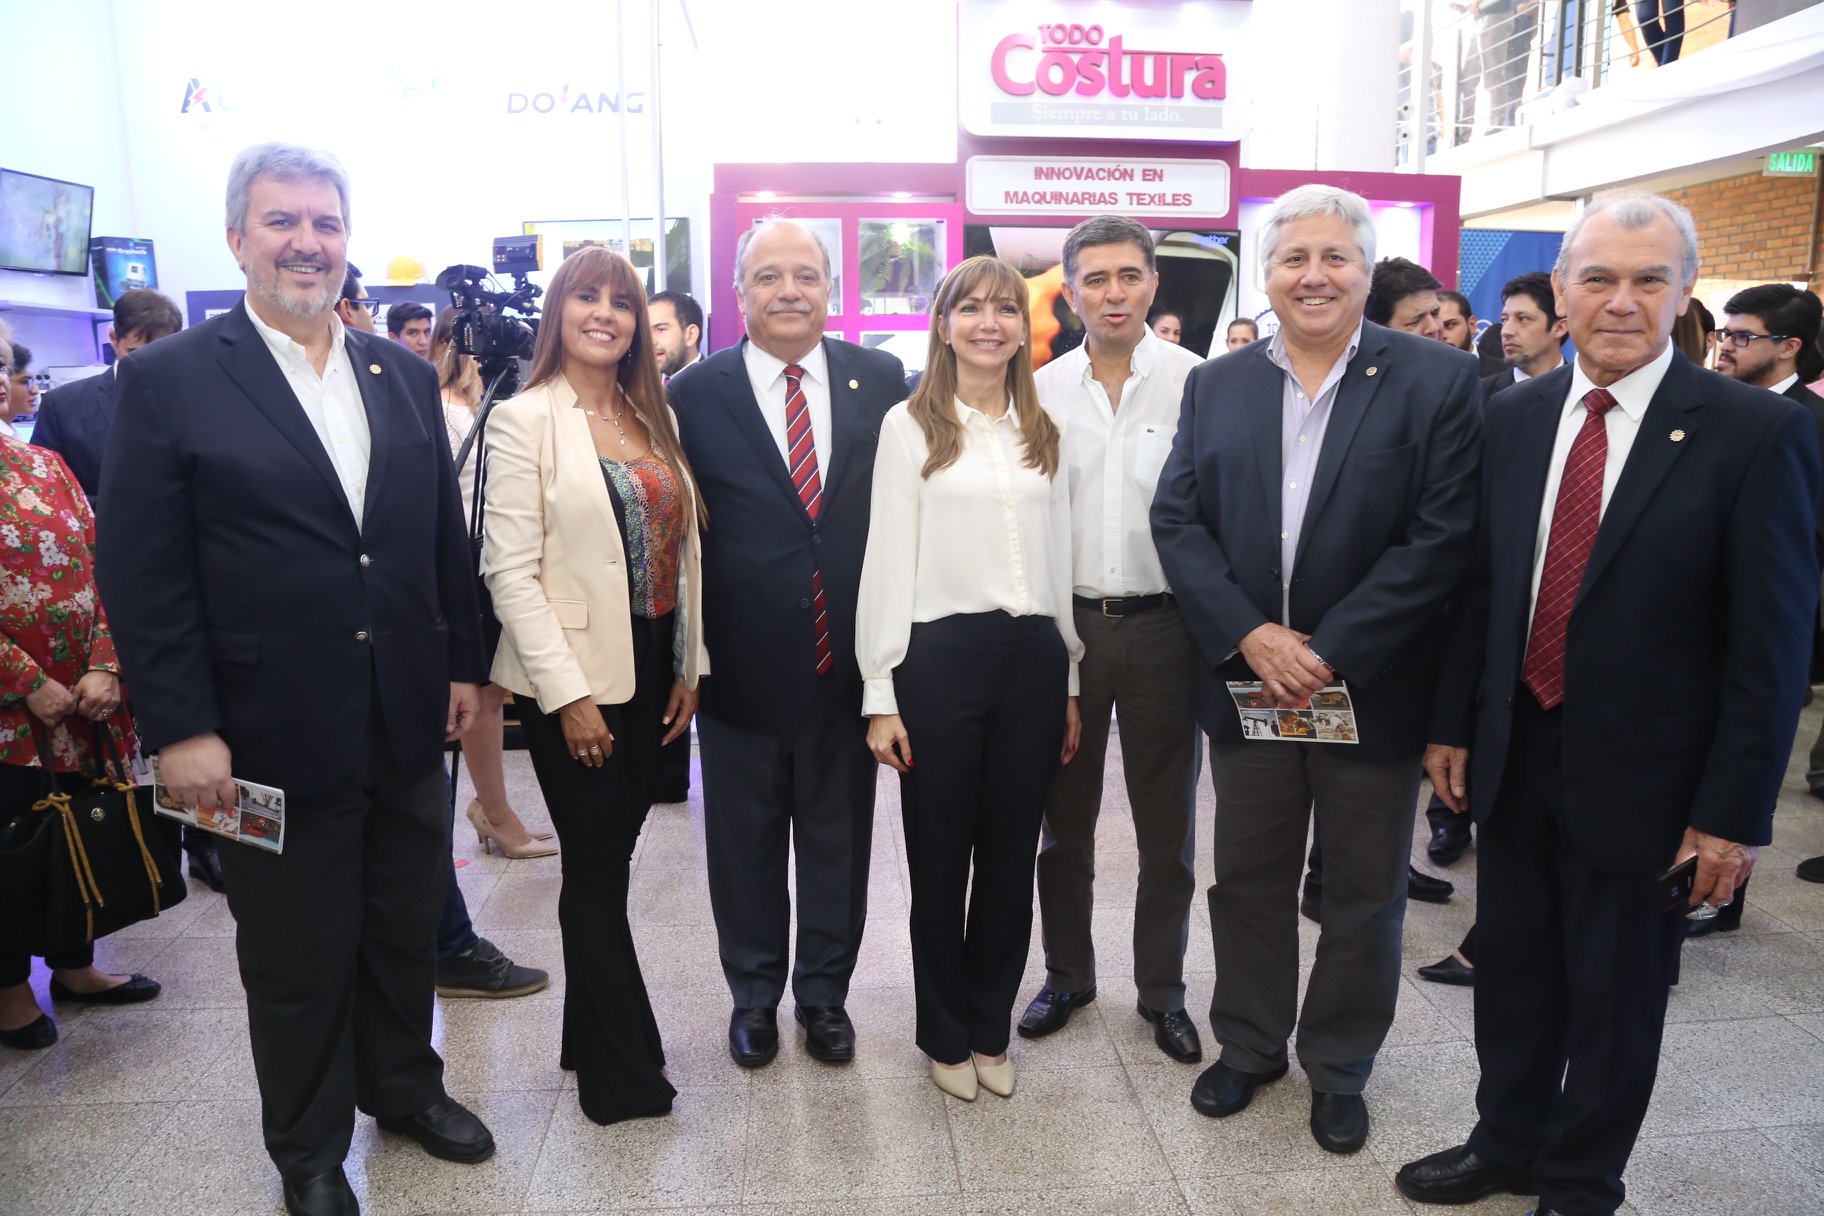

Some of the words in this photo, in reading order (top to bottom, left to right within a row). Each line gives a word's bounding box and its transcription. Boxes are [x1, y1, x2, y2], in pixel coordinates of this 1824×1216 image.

[1037, 22, 1105, 46] TODO
[990, 32, 1227, 101] Costura
[1031, 103, 1102, 124] Siempre
[1106, 109, 1116, 121] a
[1121, 107, 1138, 122] tu
[1144, 106, 1184, 122] lado.
[1034, 164, 1134, 182] INNOVACIÓN
[1141, 168, 1164, 182] EN
[1768, 153, 1814, 173] SALIDA
[1004, 190, 1119, 206] MAQUINARIAS
[1126, 192, 1193, 207] TEXILES
